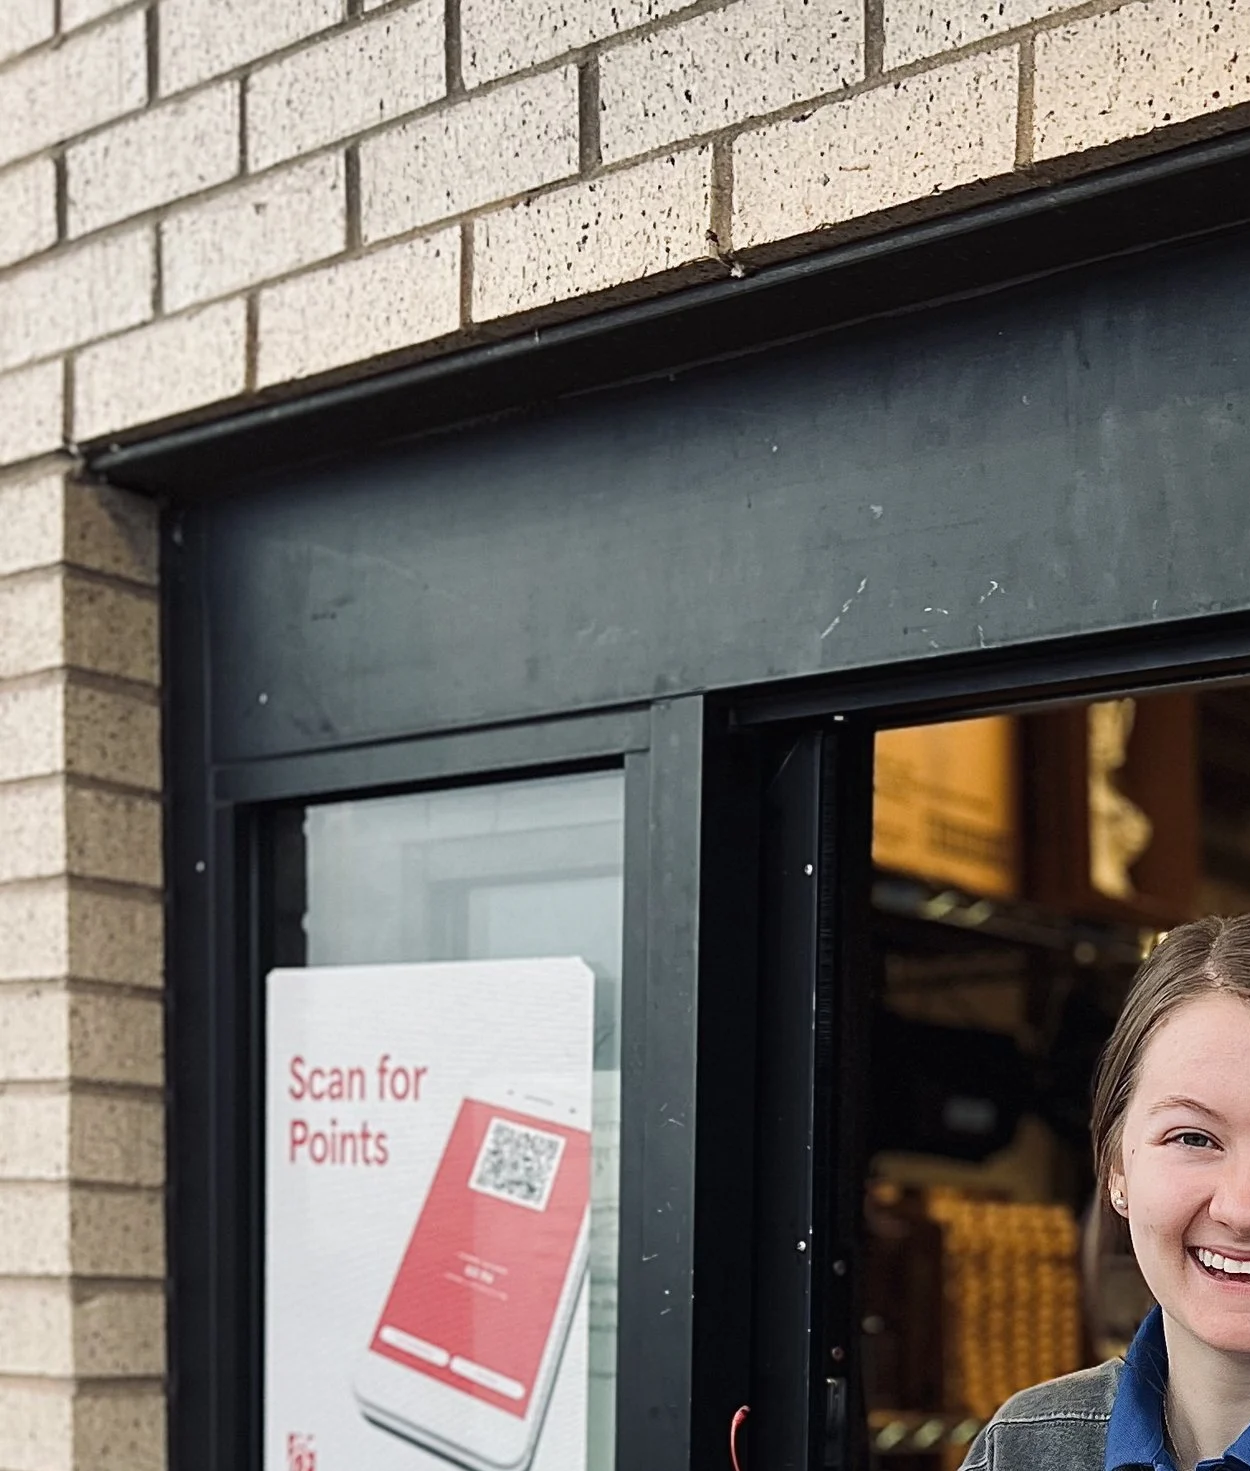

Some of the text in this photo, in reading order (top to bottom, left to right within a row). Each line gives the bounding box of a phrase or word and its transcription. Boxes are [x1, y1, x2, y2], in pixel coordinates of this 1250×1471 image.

[288, 1053, 428, 1101] Scan for
[288, 1119, 390, 1166] Points
